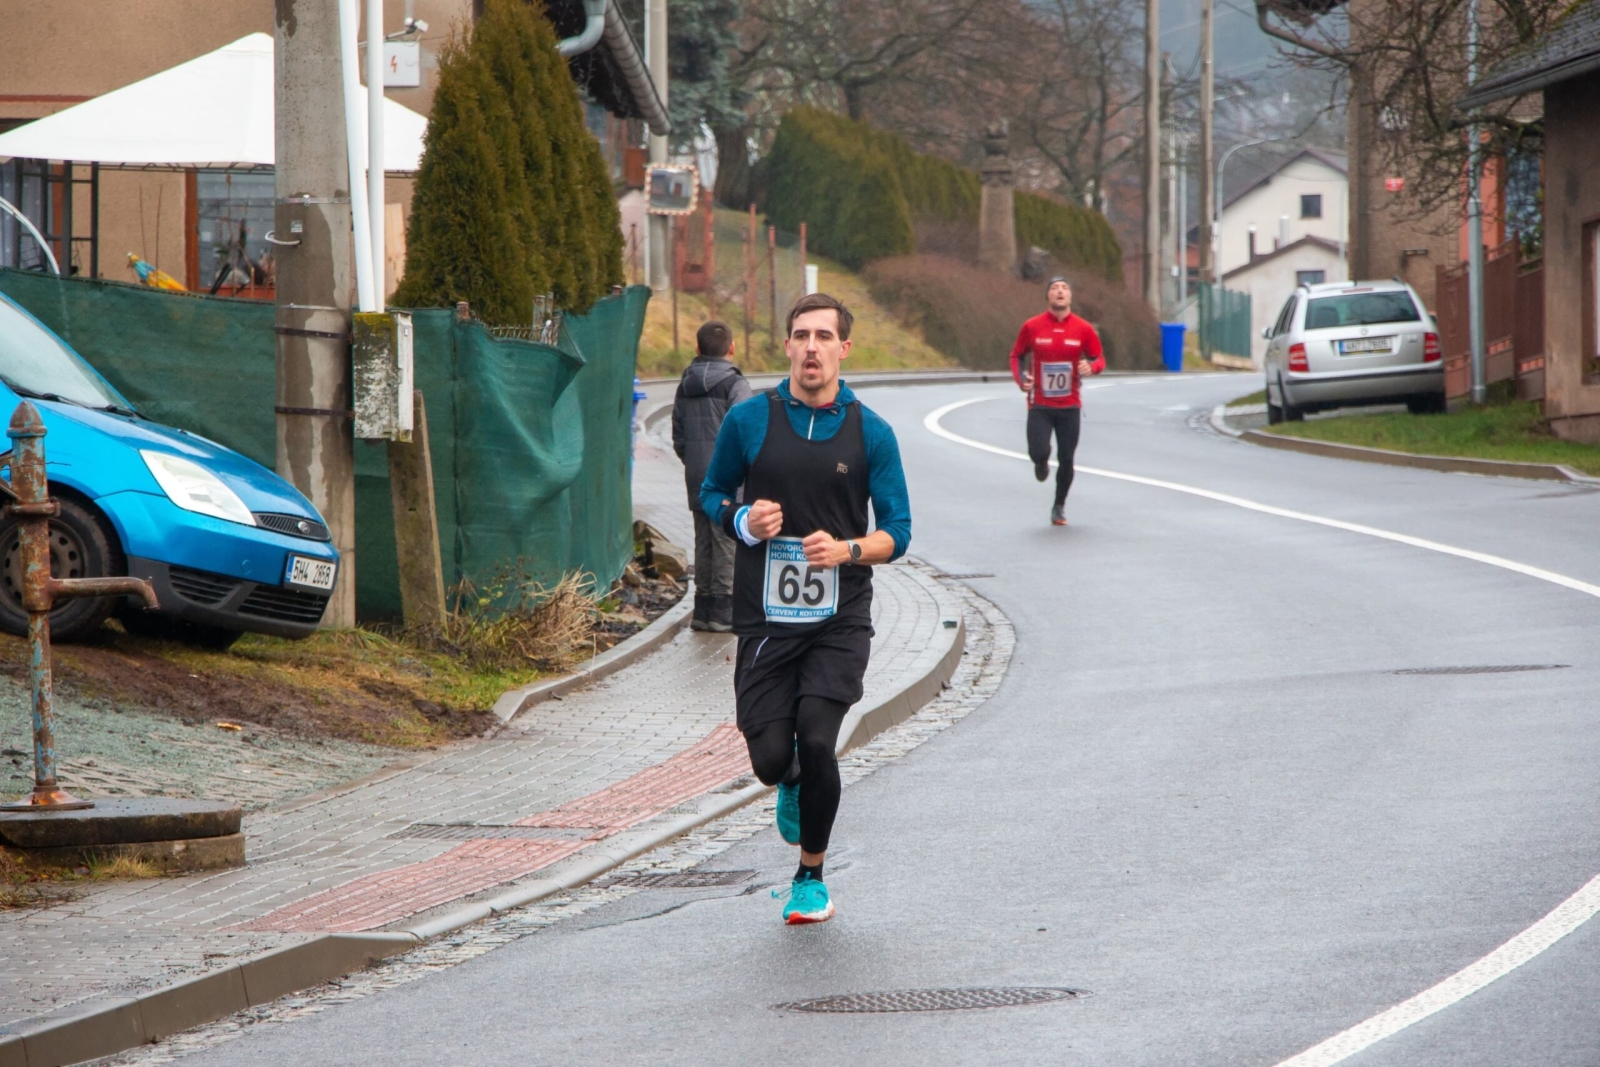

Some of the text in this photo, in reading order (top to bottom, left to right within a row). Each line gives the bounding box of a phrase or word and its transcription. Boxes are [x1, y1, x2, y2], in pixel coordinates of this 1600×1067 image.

[1047, 373, 1066, 389] 70
[771, 551, 796, 560] HORNÍ
[293, 560, 309, 582] 5H4
[778, 564, 825, 606] 65
[767, 607, 833, 617] ČERVENÝ KOSTELEC
